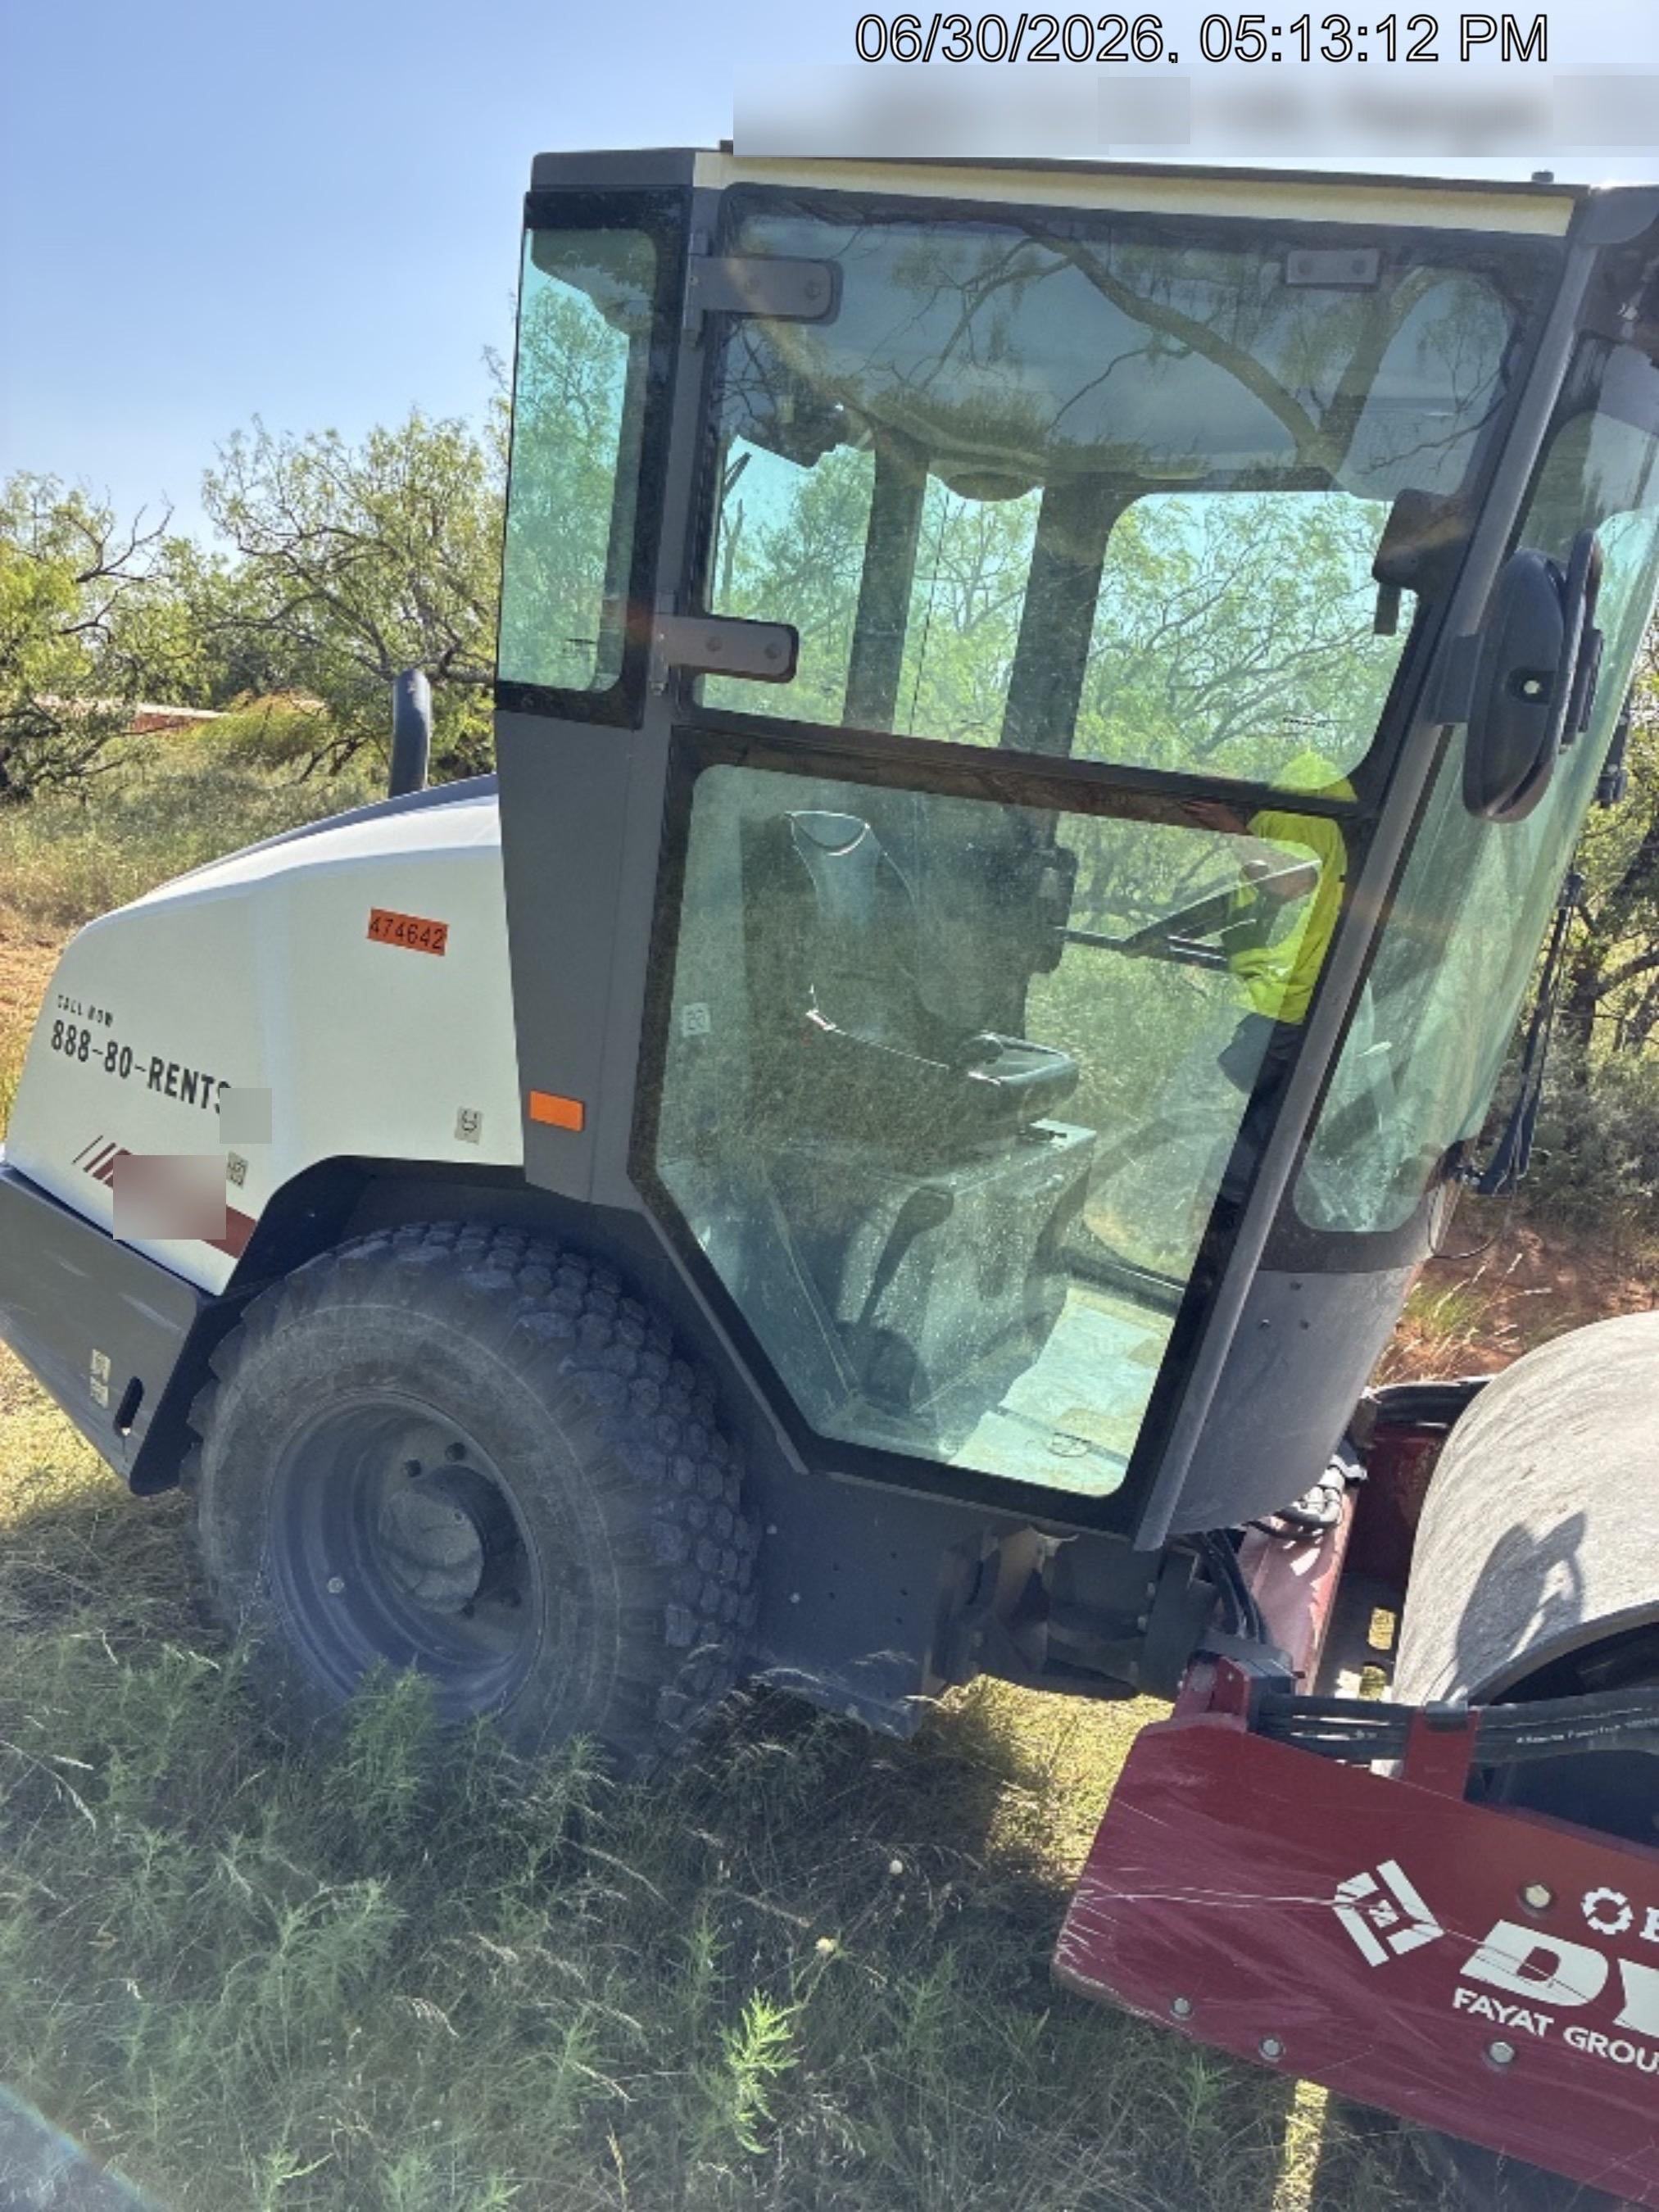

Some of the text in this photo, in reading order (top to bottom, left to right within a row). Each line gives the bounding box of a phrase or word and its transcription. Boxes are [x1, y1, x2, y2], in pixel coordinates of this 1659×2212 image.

[369, 917, 444, 950] 474642
[1453, 1986, 1659, 2075] FAYAT GROU
